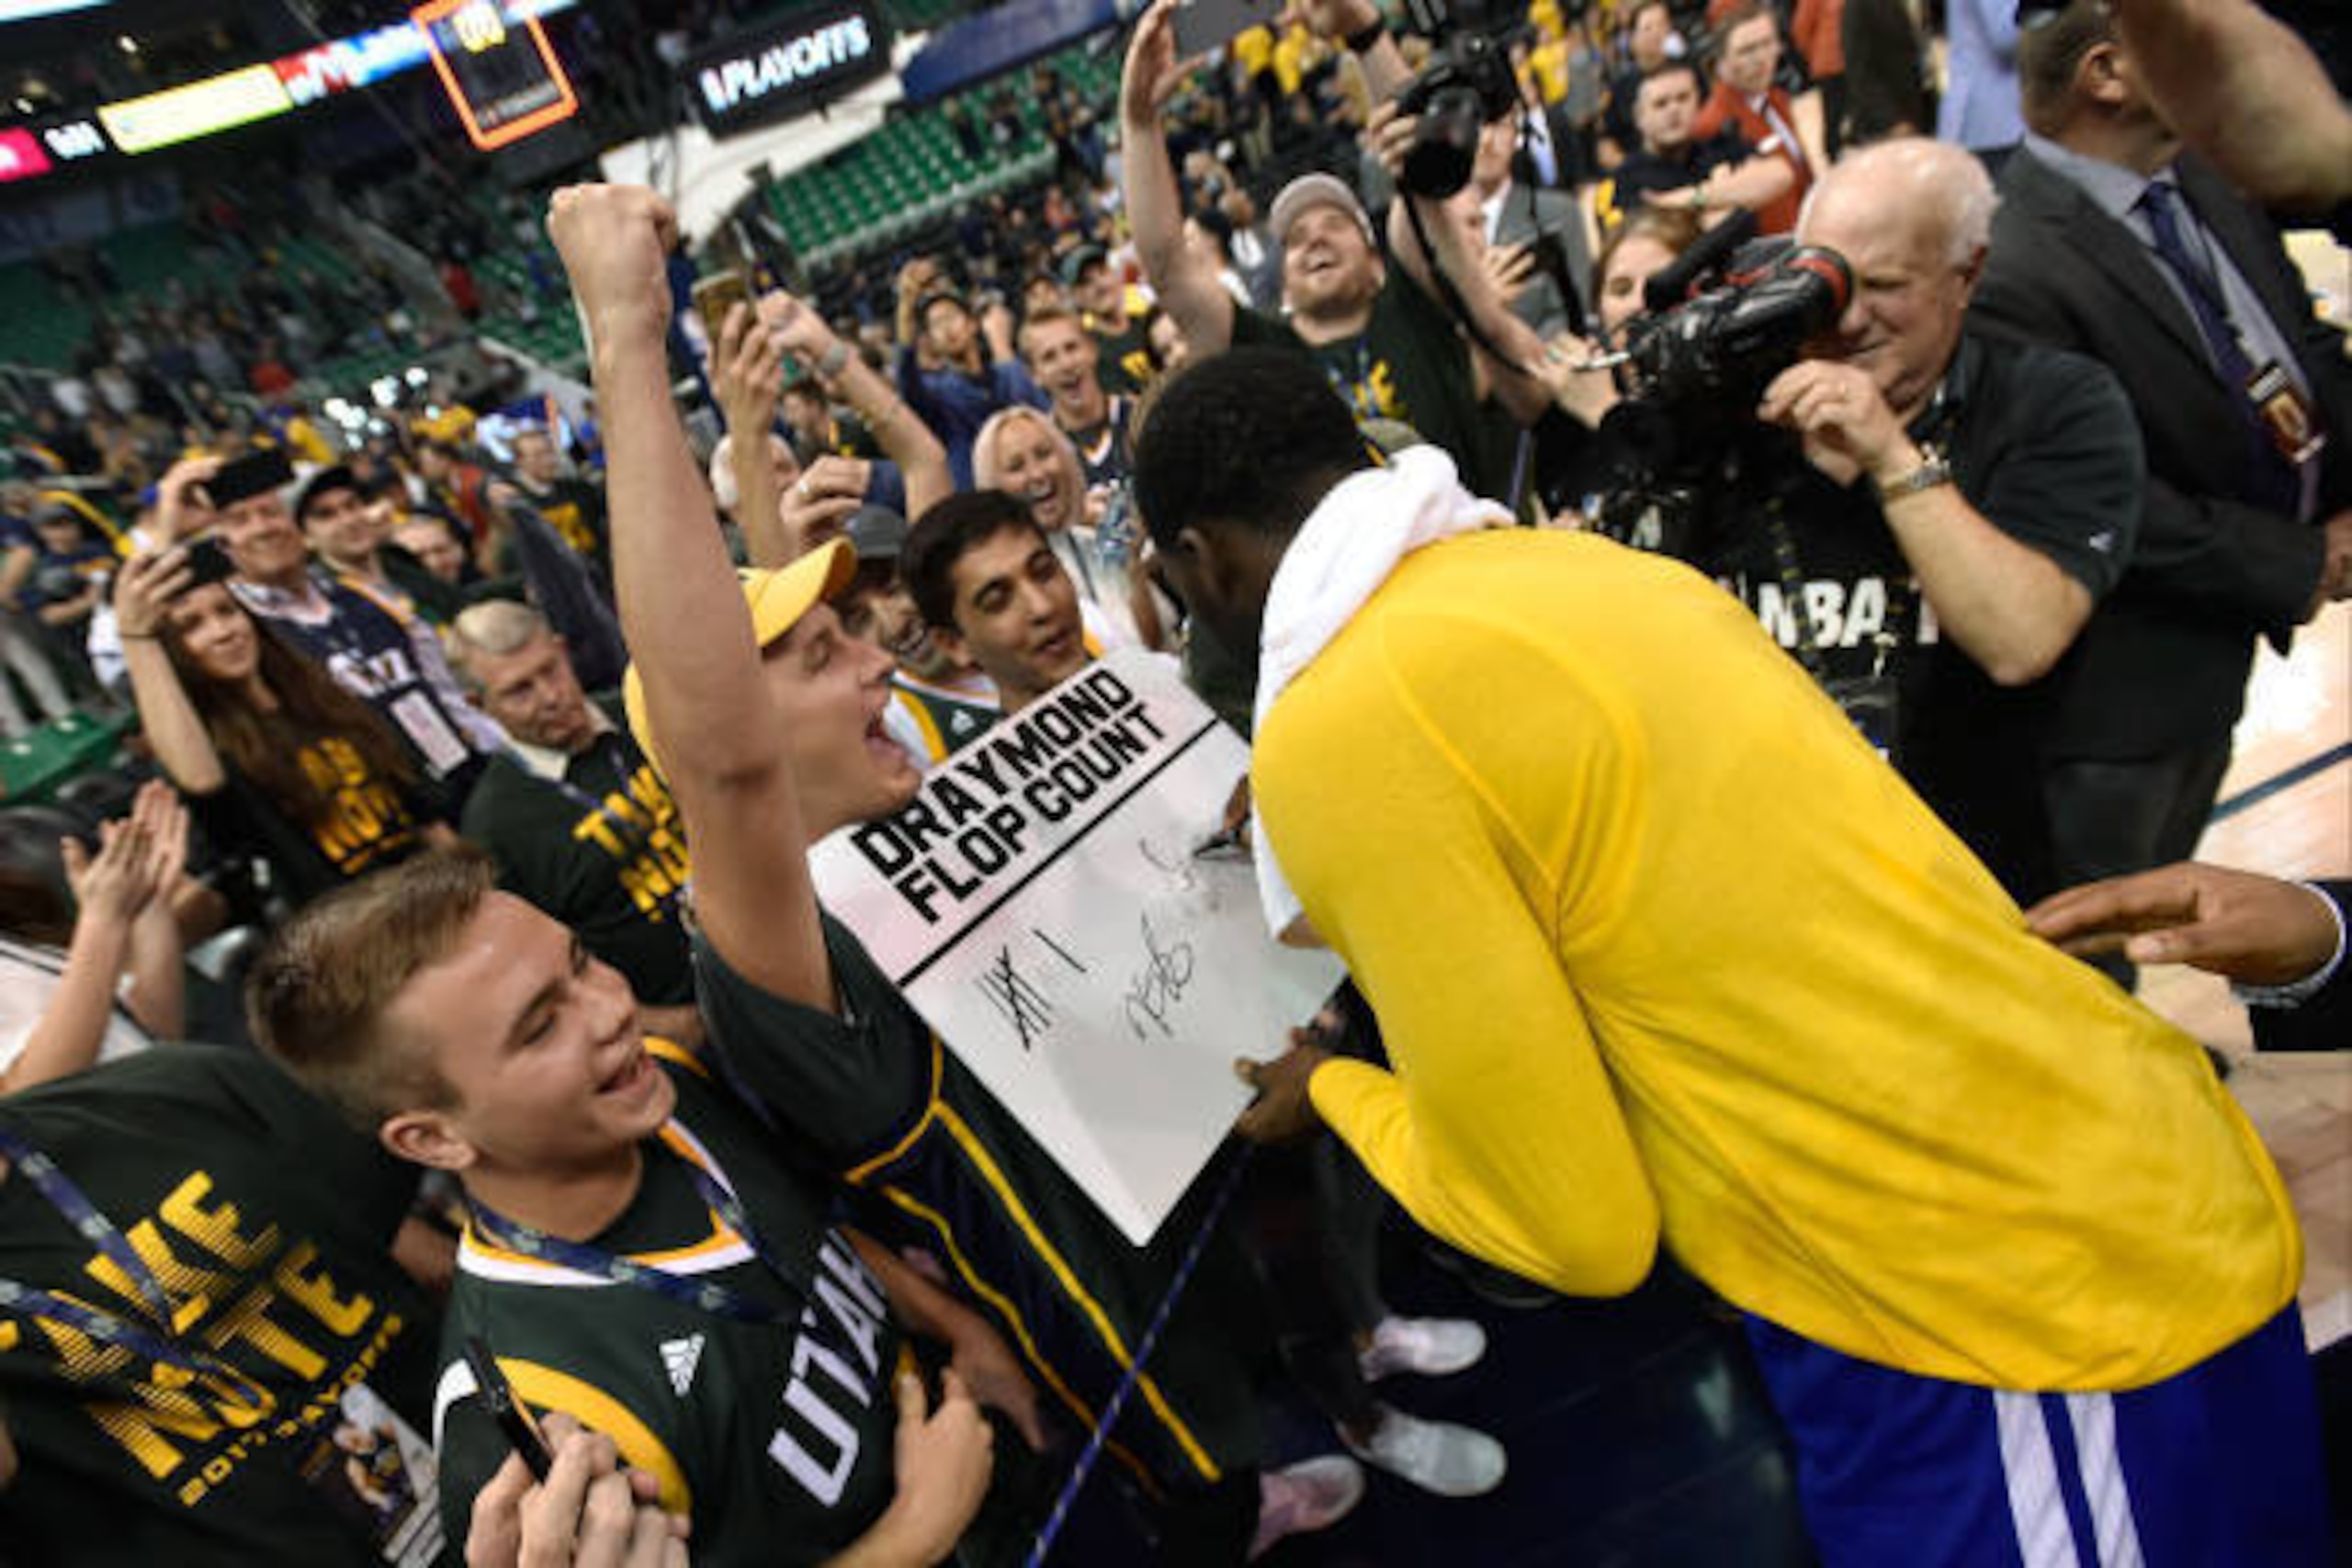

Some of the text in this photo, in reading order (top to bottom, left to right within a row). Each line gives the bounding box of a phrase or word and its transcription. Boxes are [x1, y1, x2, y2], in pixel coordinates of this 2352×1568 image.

[721, 15, 871, 107] PLAYOFFS
[1757, 578, 1888, 649] NBA
[850, 669, 1135, 879] DRAYMOND
[895, 806, 1025, 924] FLOP
[1022, 703, 1166, 824] COUNT
[0, 1170, 278, 1380] AKE
[85, 1240, 375, 1480] NOTE
[766, 1227, 888, 1507] UTAH
